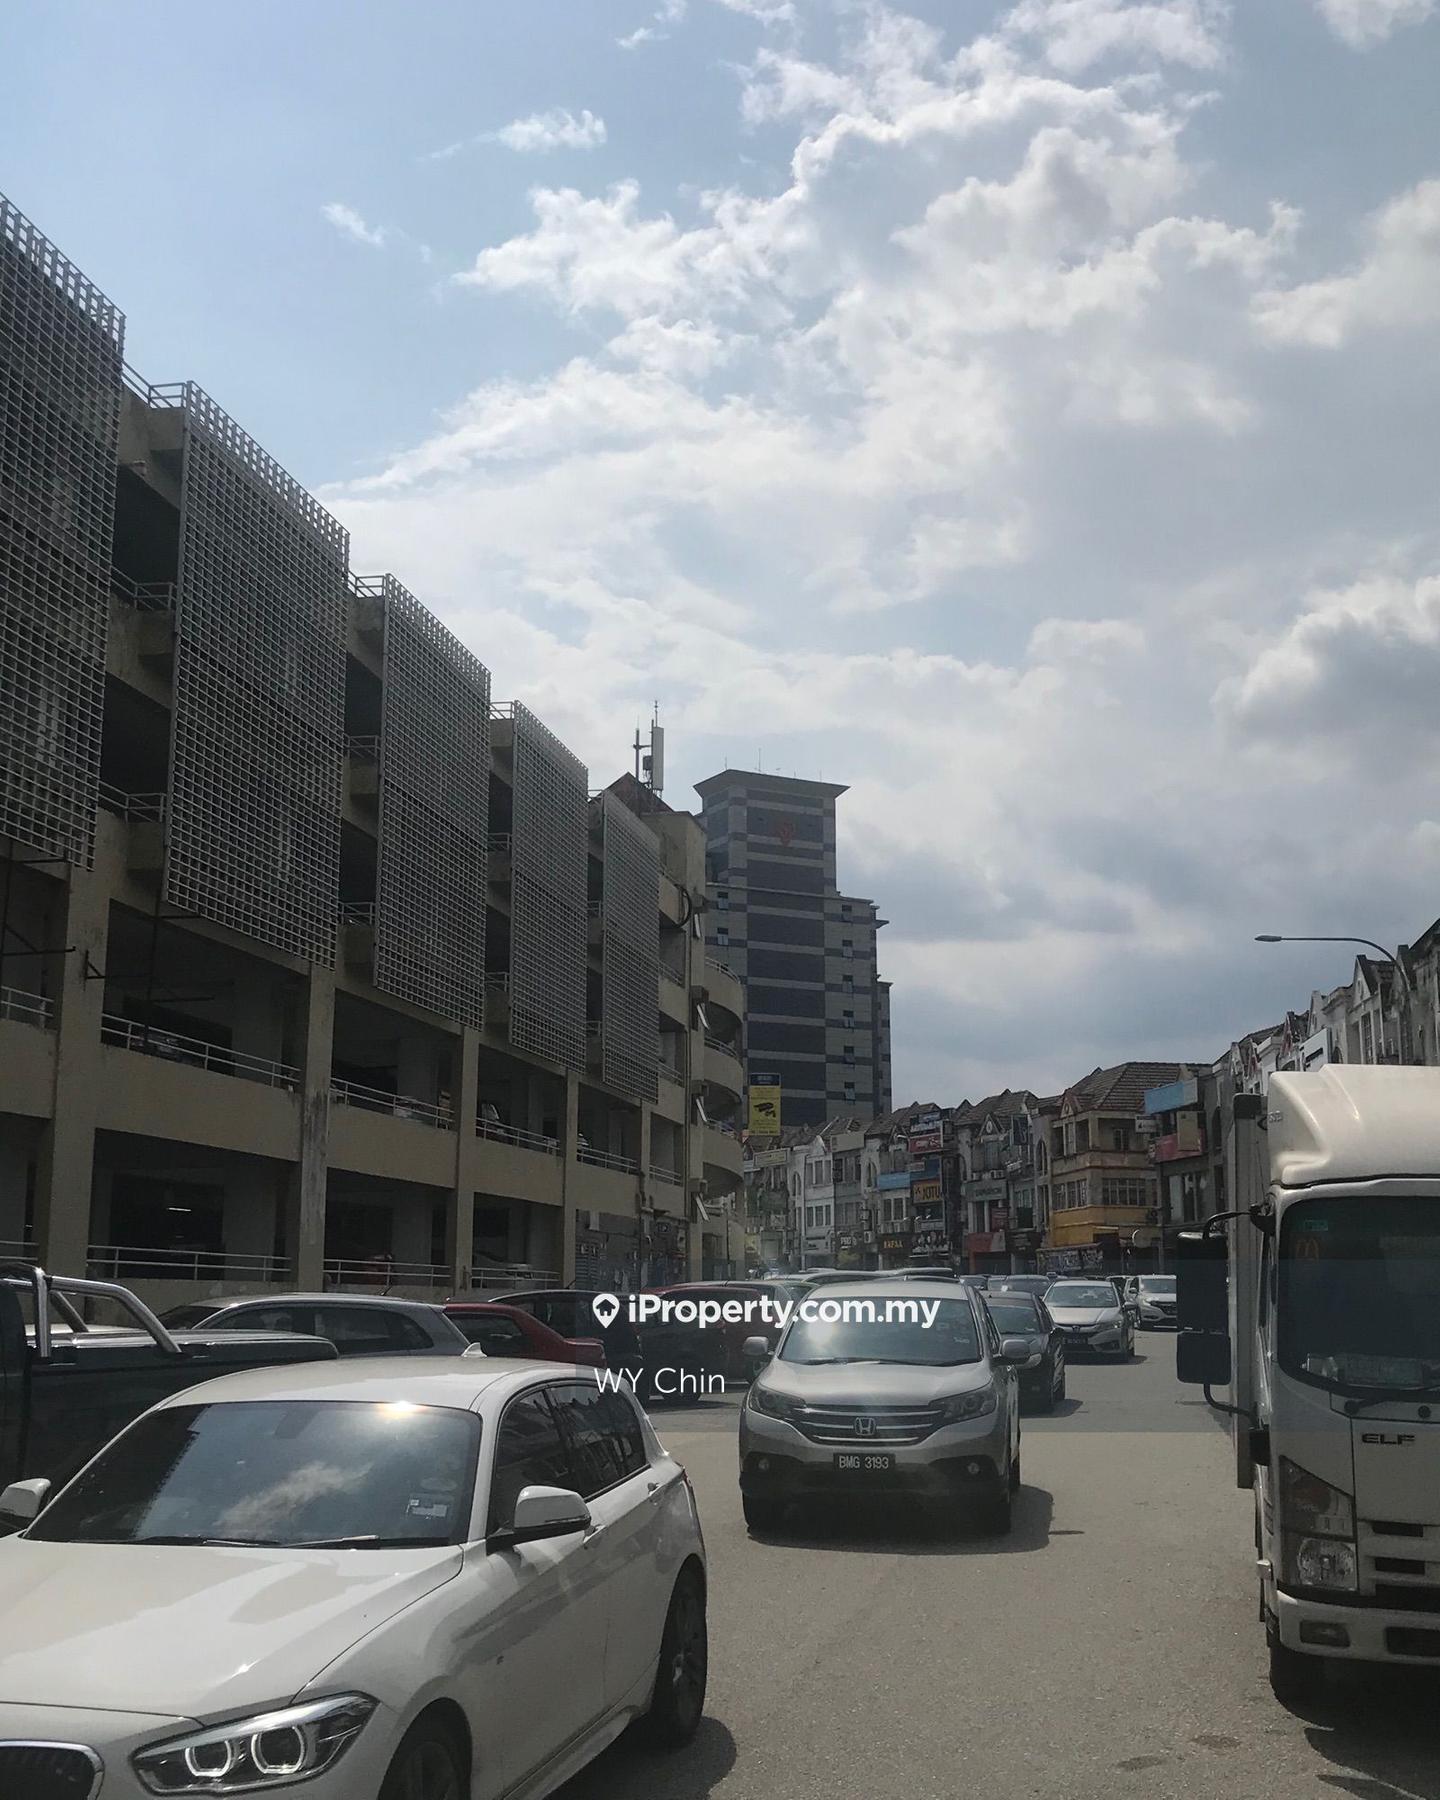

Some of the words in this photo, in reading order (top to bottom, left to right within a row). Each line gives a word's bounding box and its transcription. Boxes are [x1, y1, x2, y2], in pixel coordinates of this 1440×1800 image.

[1361, 1433, 1416, 1445] ELF
[838, 1455, 861, 1469] BMG
[864, 1455, 889, 1470] 3193
